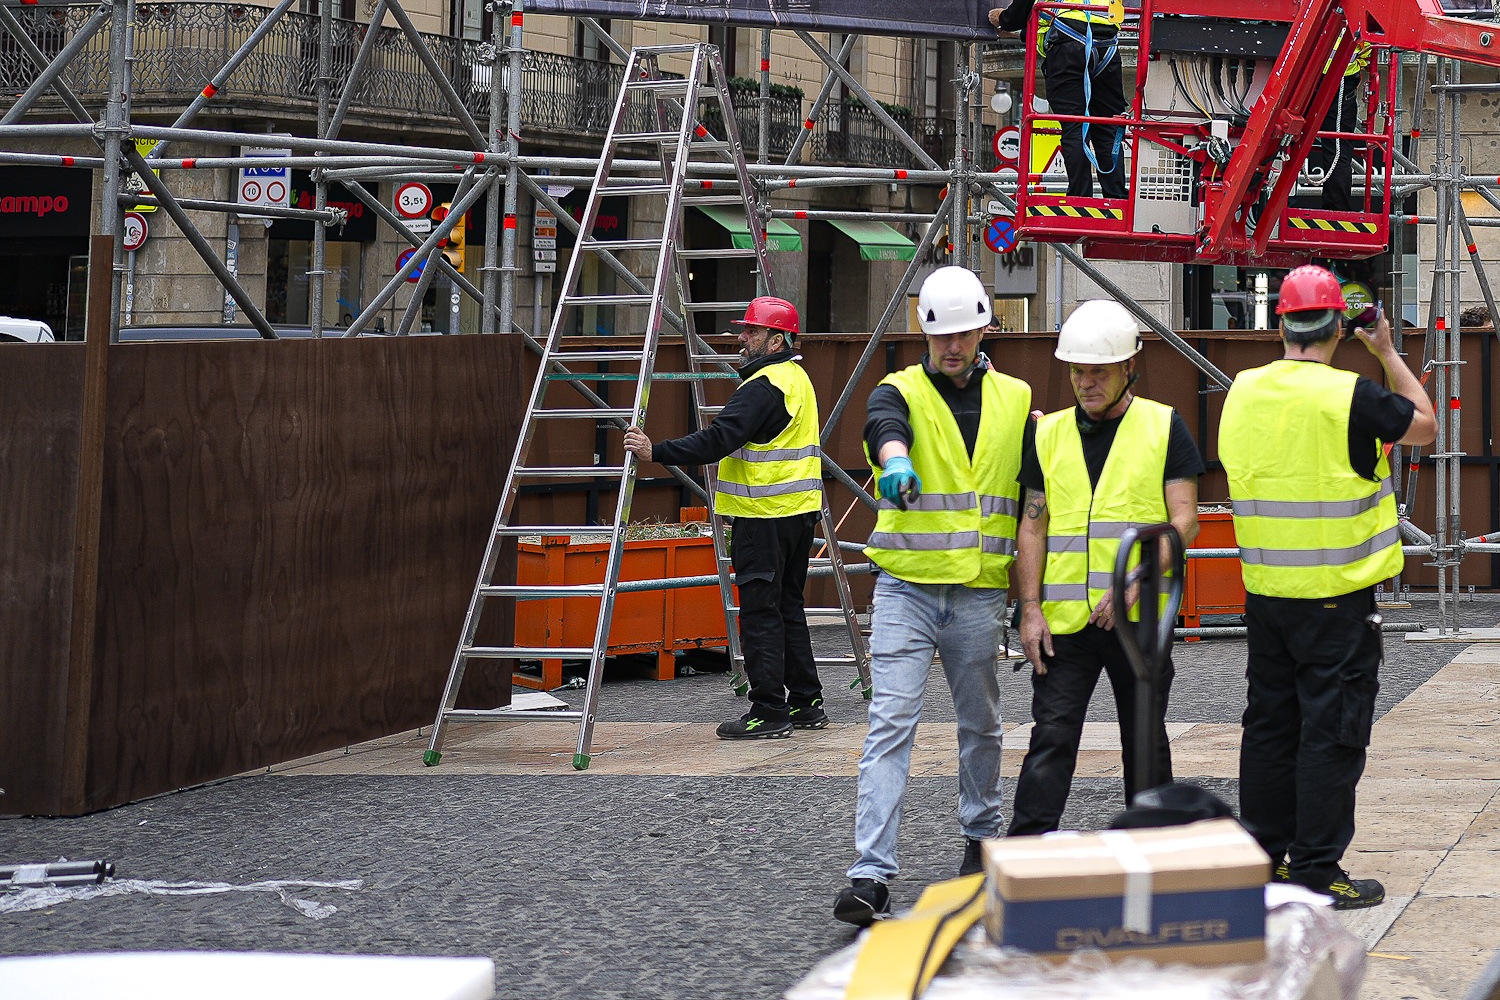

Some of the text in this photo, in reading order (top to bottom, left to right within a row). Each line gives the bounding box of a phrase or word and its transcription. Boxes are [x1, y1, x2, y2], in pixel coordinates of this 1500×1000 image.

[247, 188, 257, 196] 10
[0, 195, 69, 217] ampo
[402, 195, 424, 206] 3,5t
